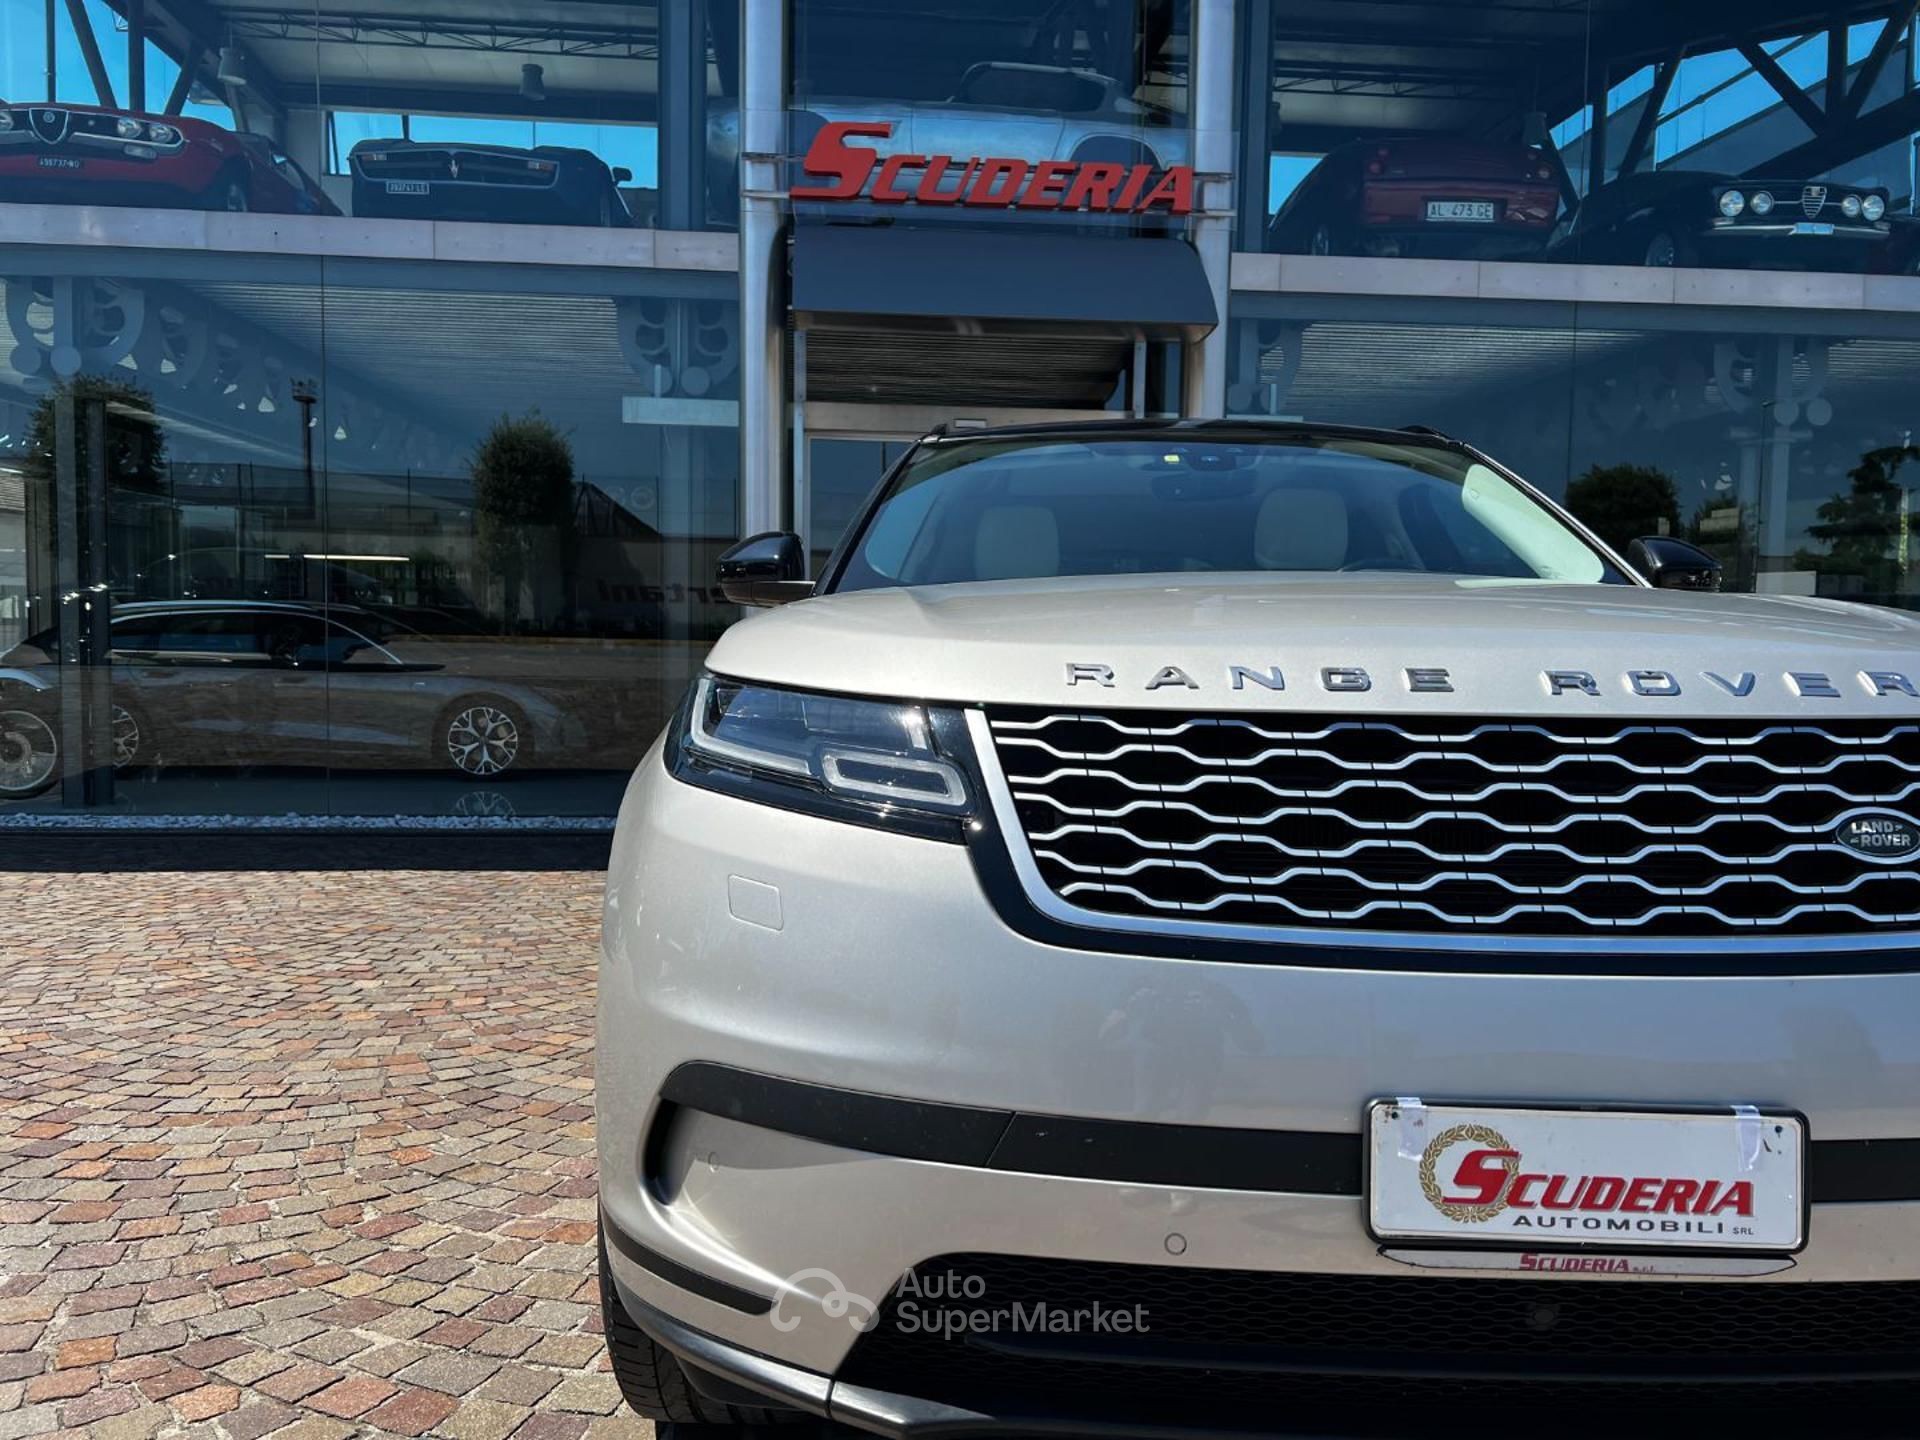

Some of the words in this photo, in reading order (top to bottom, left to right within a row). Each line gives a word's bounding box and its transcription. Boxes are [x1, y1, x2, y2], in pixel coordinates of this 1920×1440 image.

[1066, 663, 1455, 693] RANGE
[1539, 670, 1920, 698] ROVER
[1851, 821, 1894, 834] LAND
[1860, 833, 1911, 847] ROVER
[1512, 1215, 1724, 1234] AUTOMOBILI
[1732, 1226, 1754, 1236] SRL
